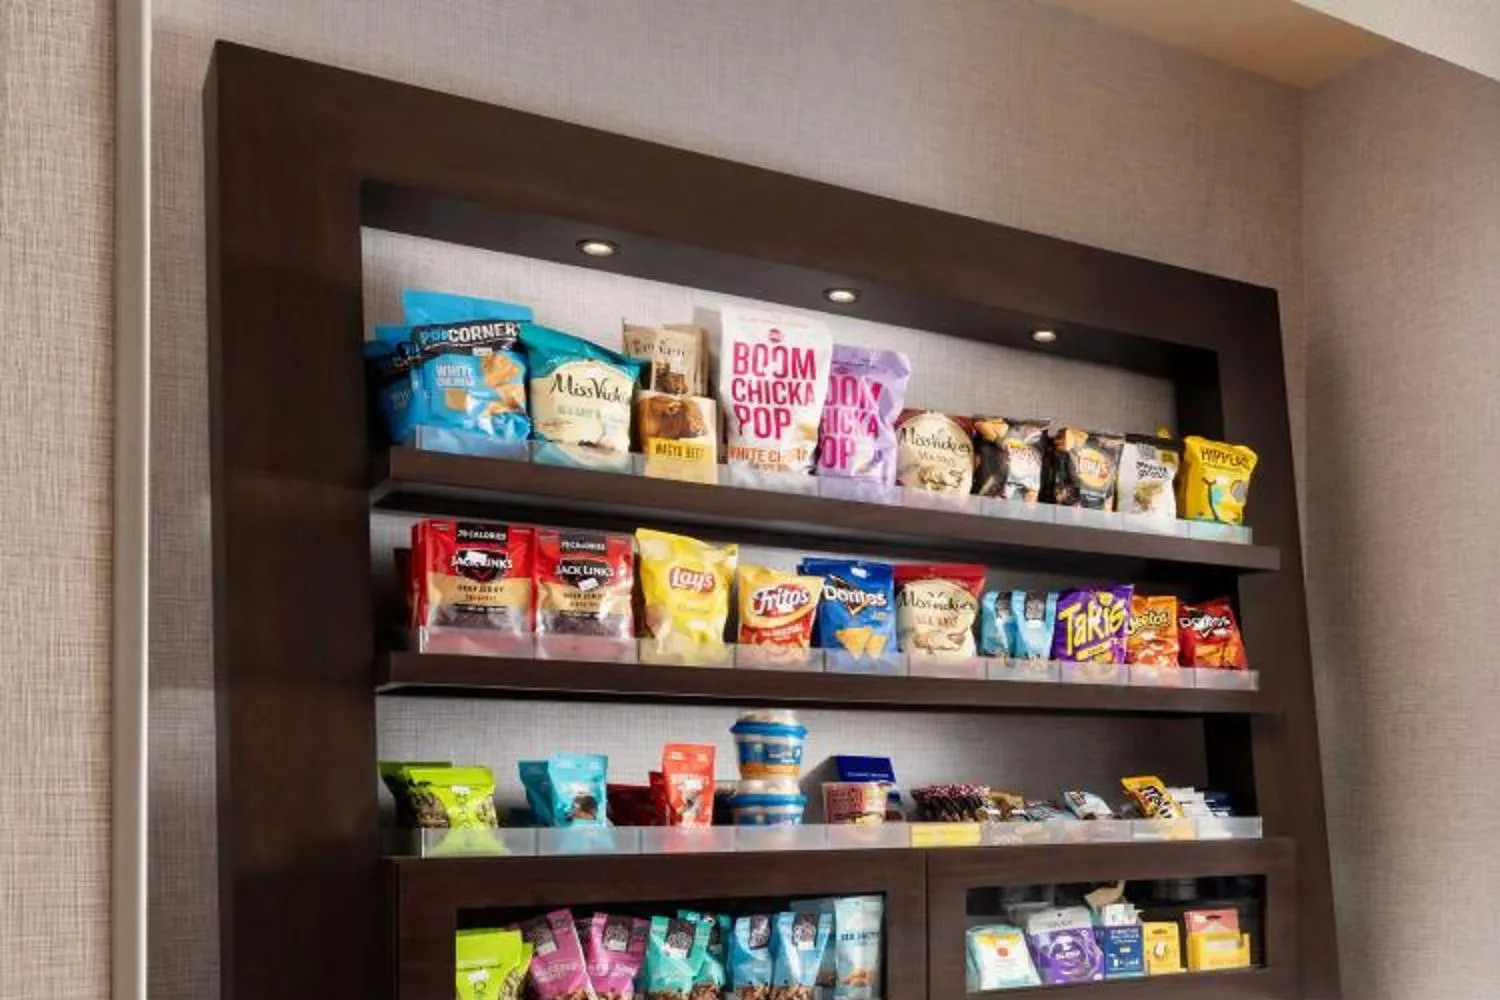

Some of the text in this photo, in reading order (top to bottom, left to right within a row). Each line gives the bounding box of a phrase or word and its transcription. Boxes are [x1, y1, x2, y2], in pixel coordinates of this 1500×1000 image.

[733, 341, 817, 381] BOOM
[731, 378, 816, 407] CHICKA
[733, 404, 792, 440] POP
[821, 435, 857, 470] OP
[753, 586, 810, 614] Fritos
[823, 585, 887, 607] Doritos
